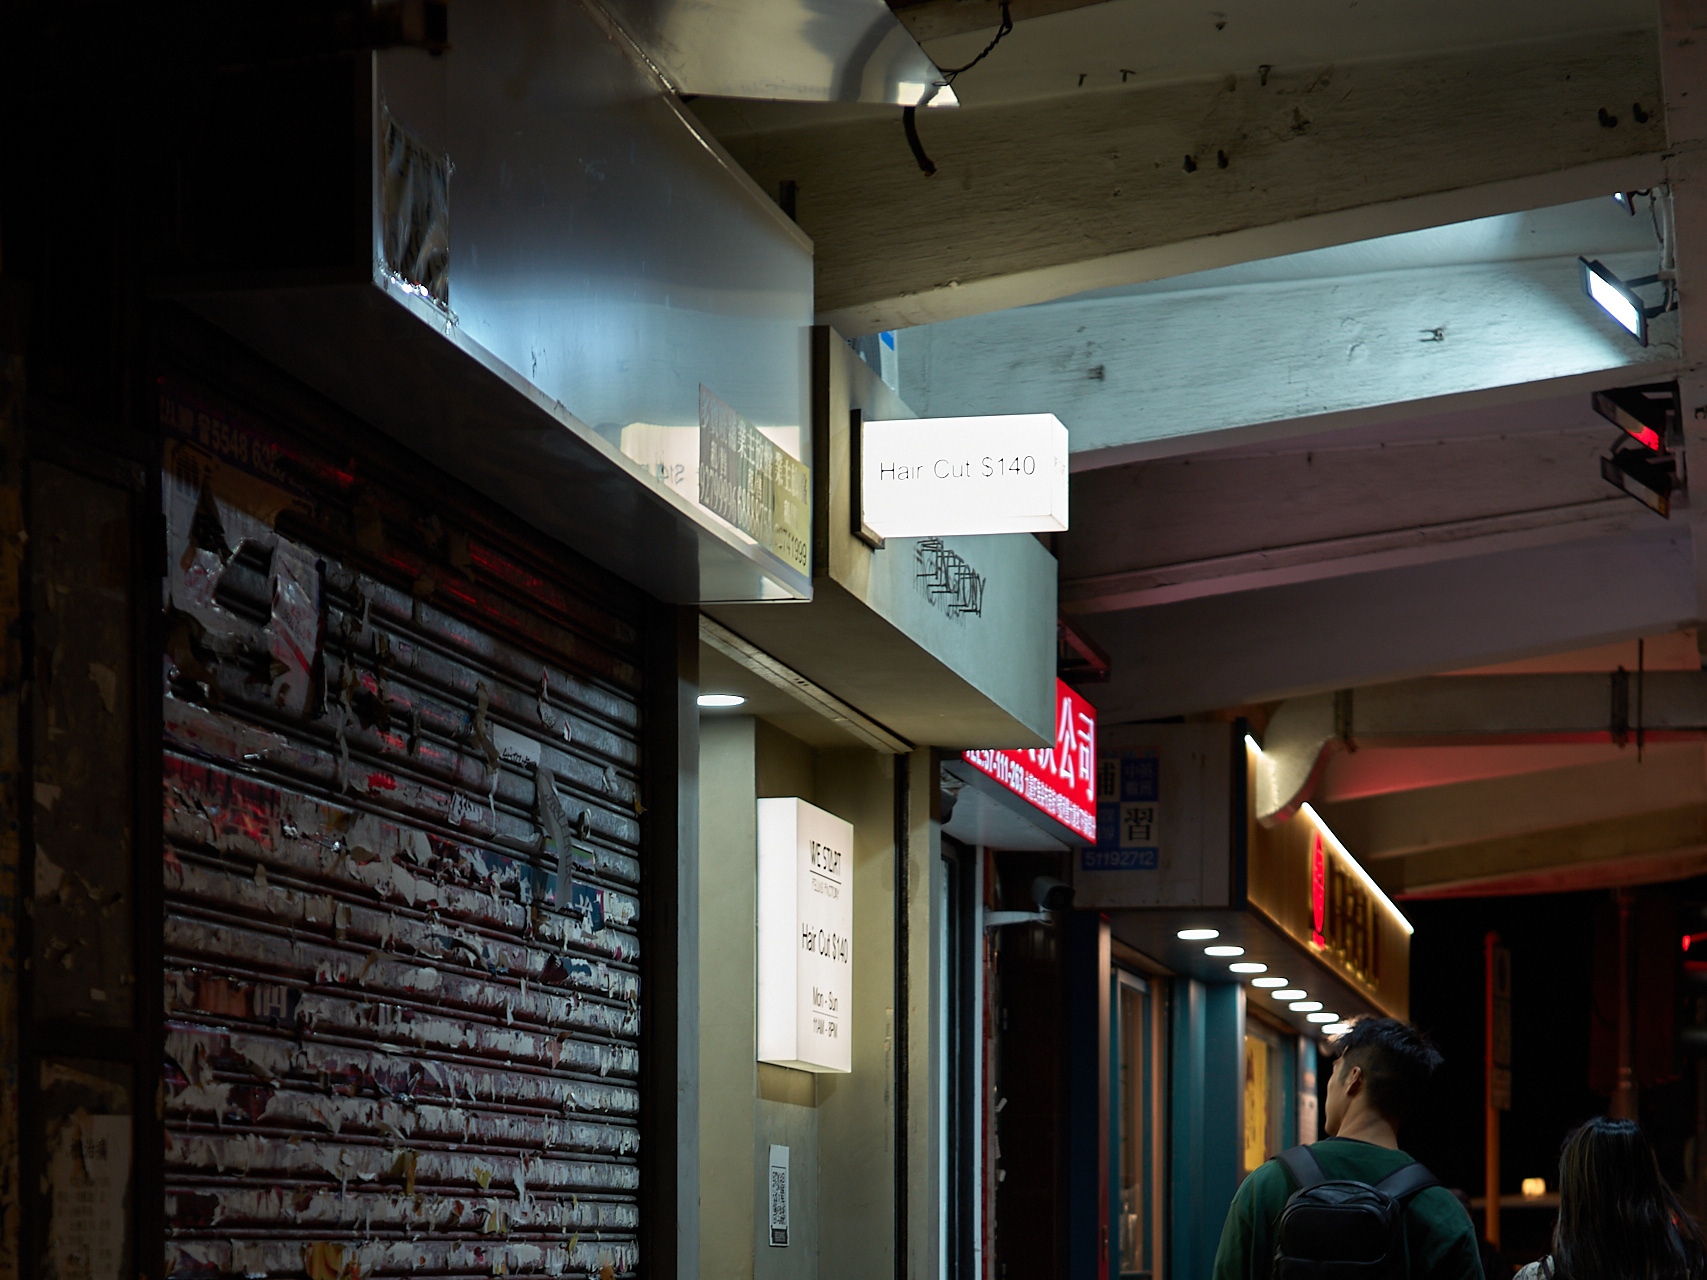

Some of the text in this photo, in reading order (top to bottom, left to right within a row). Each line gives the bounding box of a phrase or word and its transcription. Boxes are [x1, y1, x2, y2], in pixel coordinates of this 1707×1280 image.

[880, 455, 1036, 481] Hair Cut $140
[809, 839, 821, 868] WE
[1085, 851, 1154, 866] 51192712
[802, 922, 849, 964] Hair Cut $140
[812, 986, 824, 1008] Mon
[828, 990, 839, 1012] Sun
